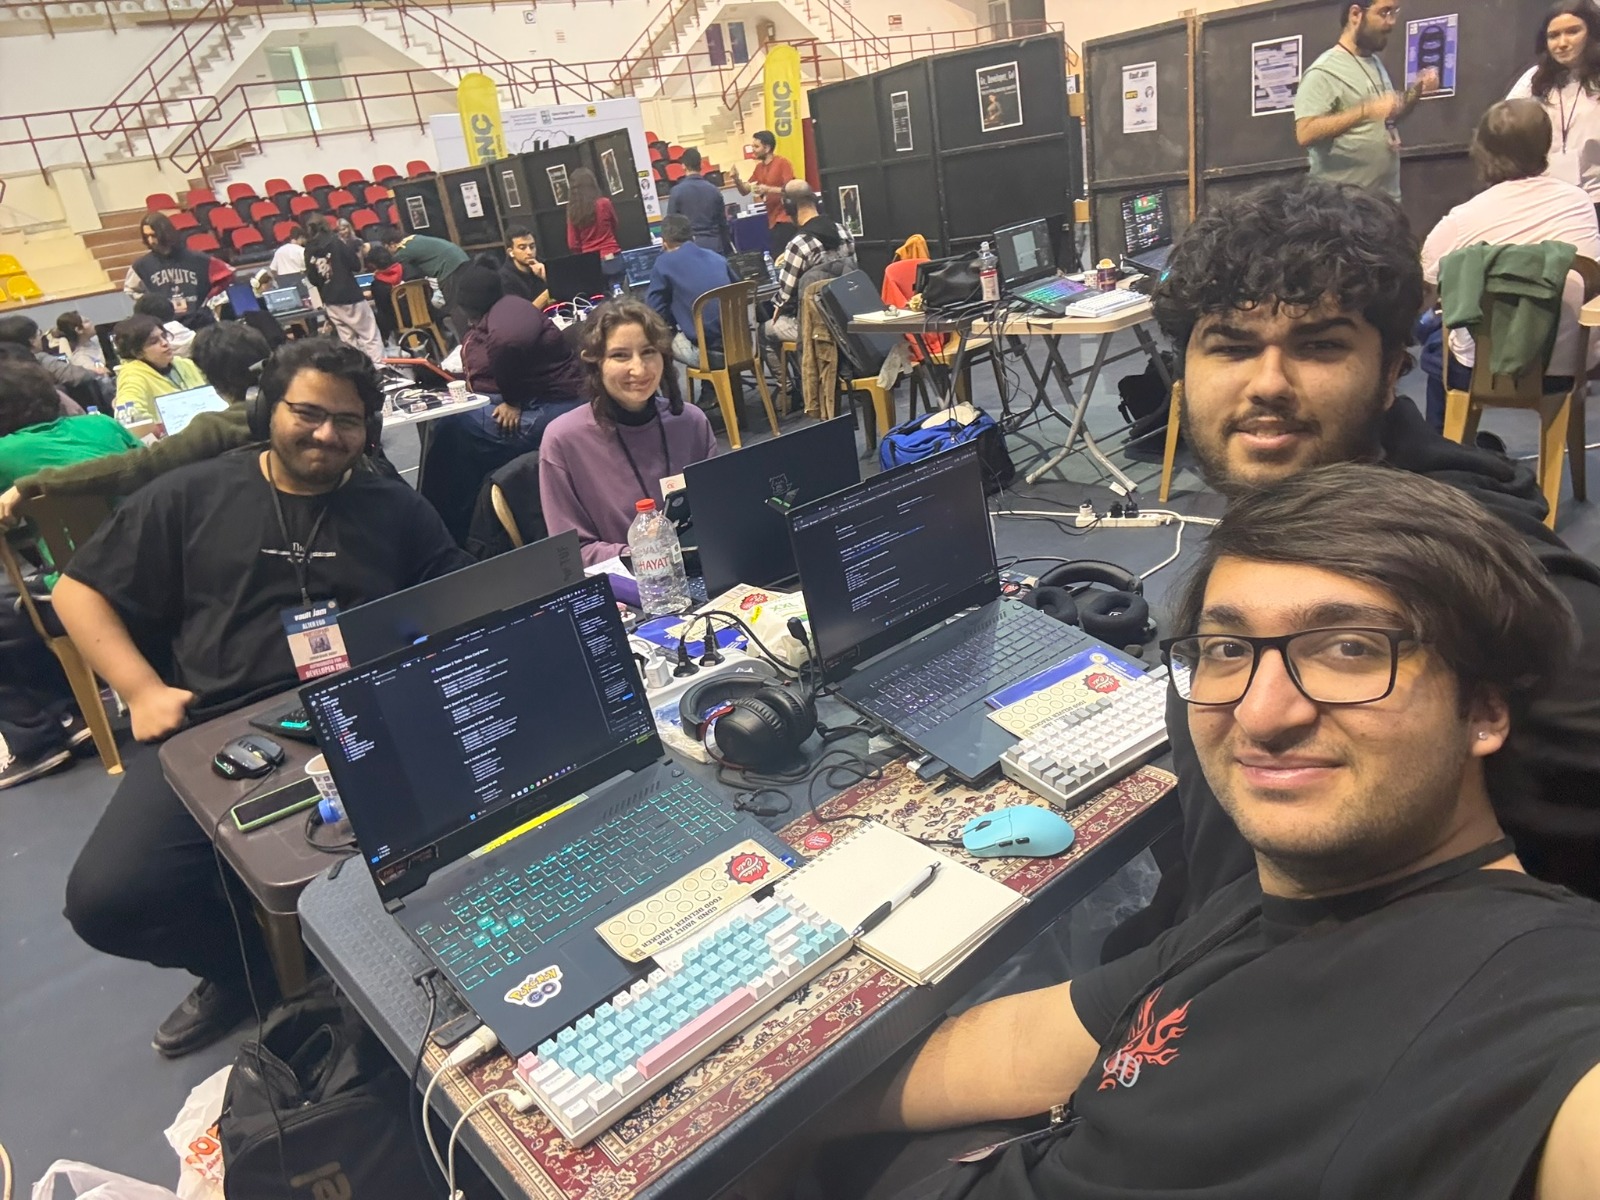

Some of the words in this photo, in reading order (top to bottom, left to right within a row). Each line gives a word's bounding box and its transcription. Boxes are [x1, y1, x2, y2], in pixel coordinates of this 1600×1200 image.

[640, 556, 669, 570] HAYAT
[736, 857, 752, 871] Cola
[743, 862, 762, 877] Nuka
[674, 908, 704, 926] DELIVER
[675, 920, 698, 936] VAULT
[641, 925, 676, 948] TRACKER
[656, 934, 674, 947] JAM
